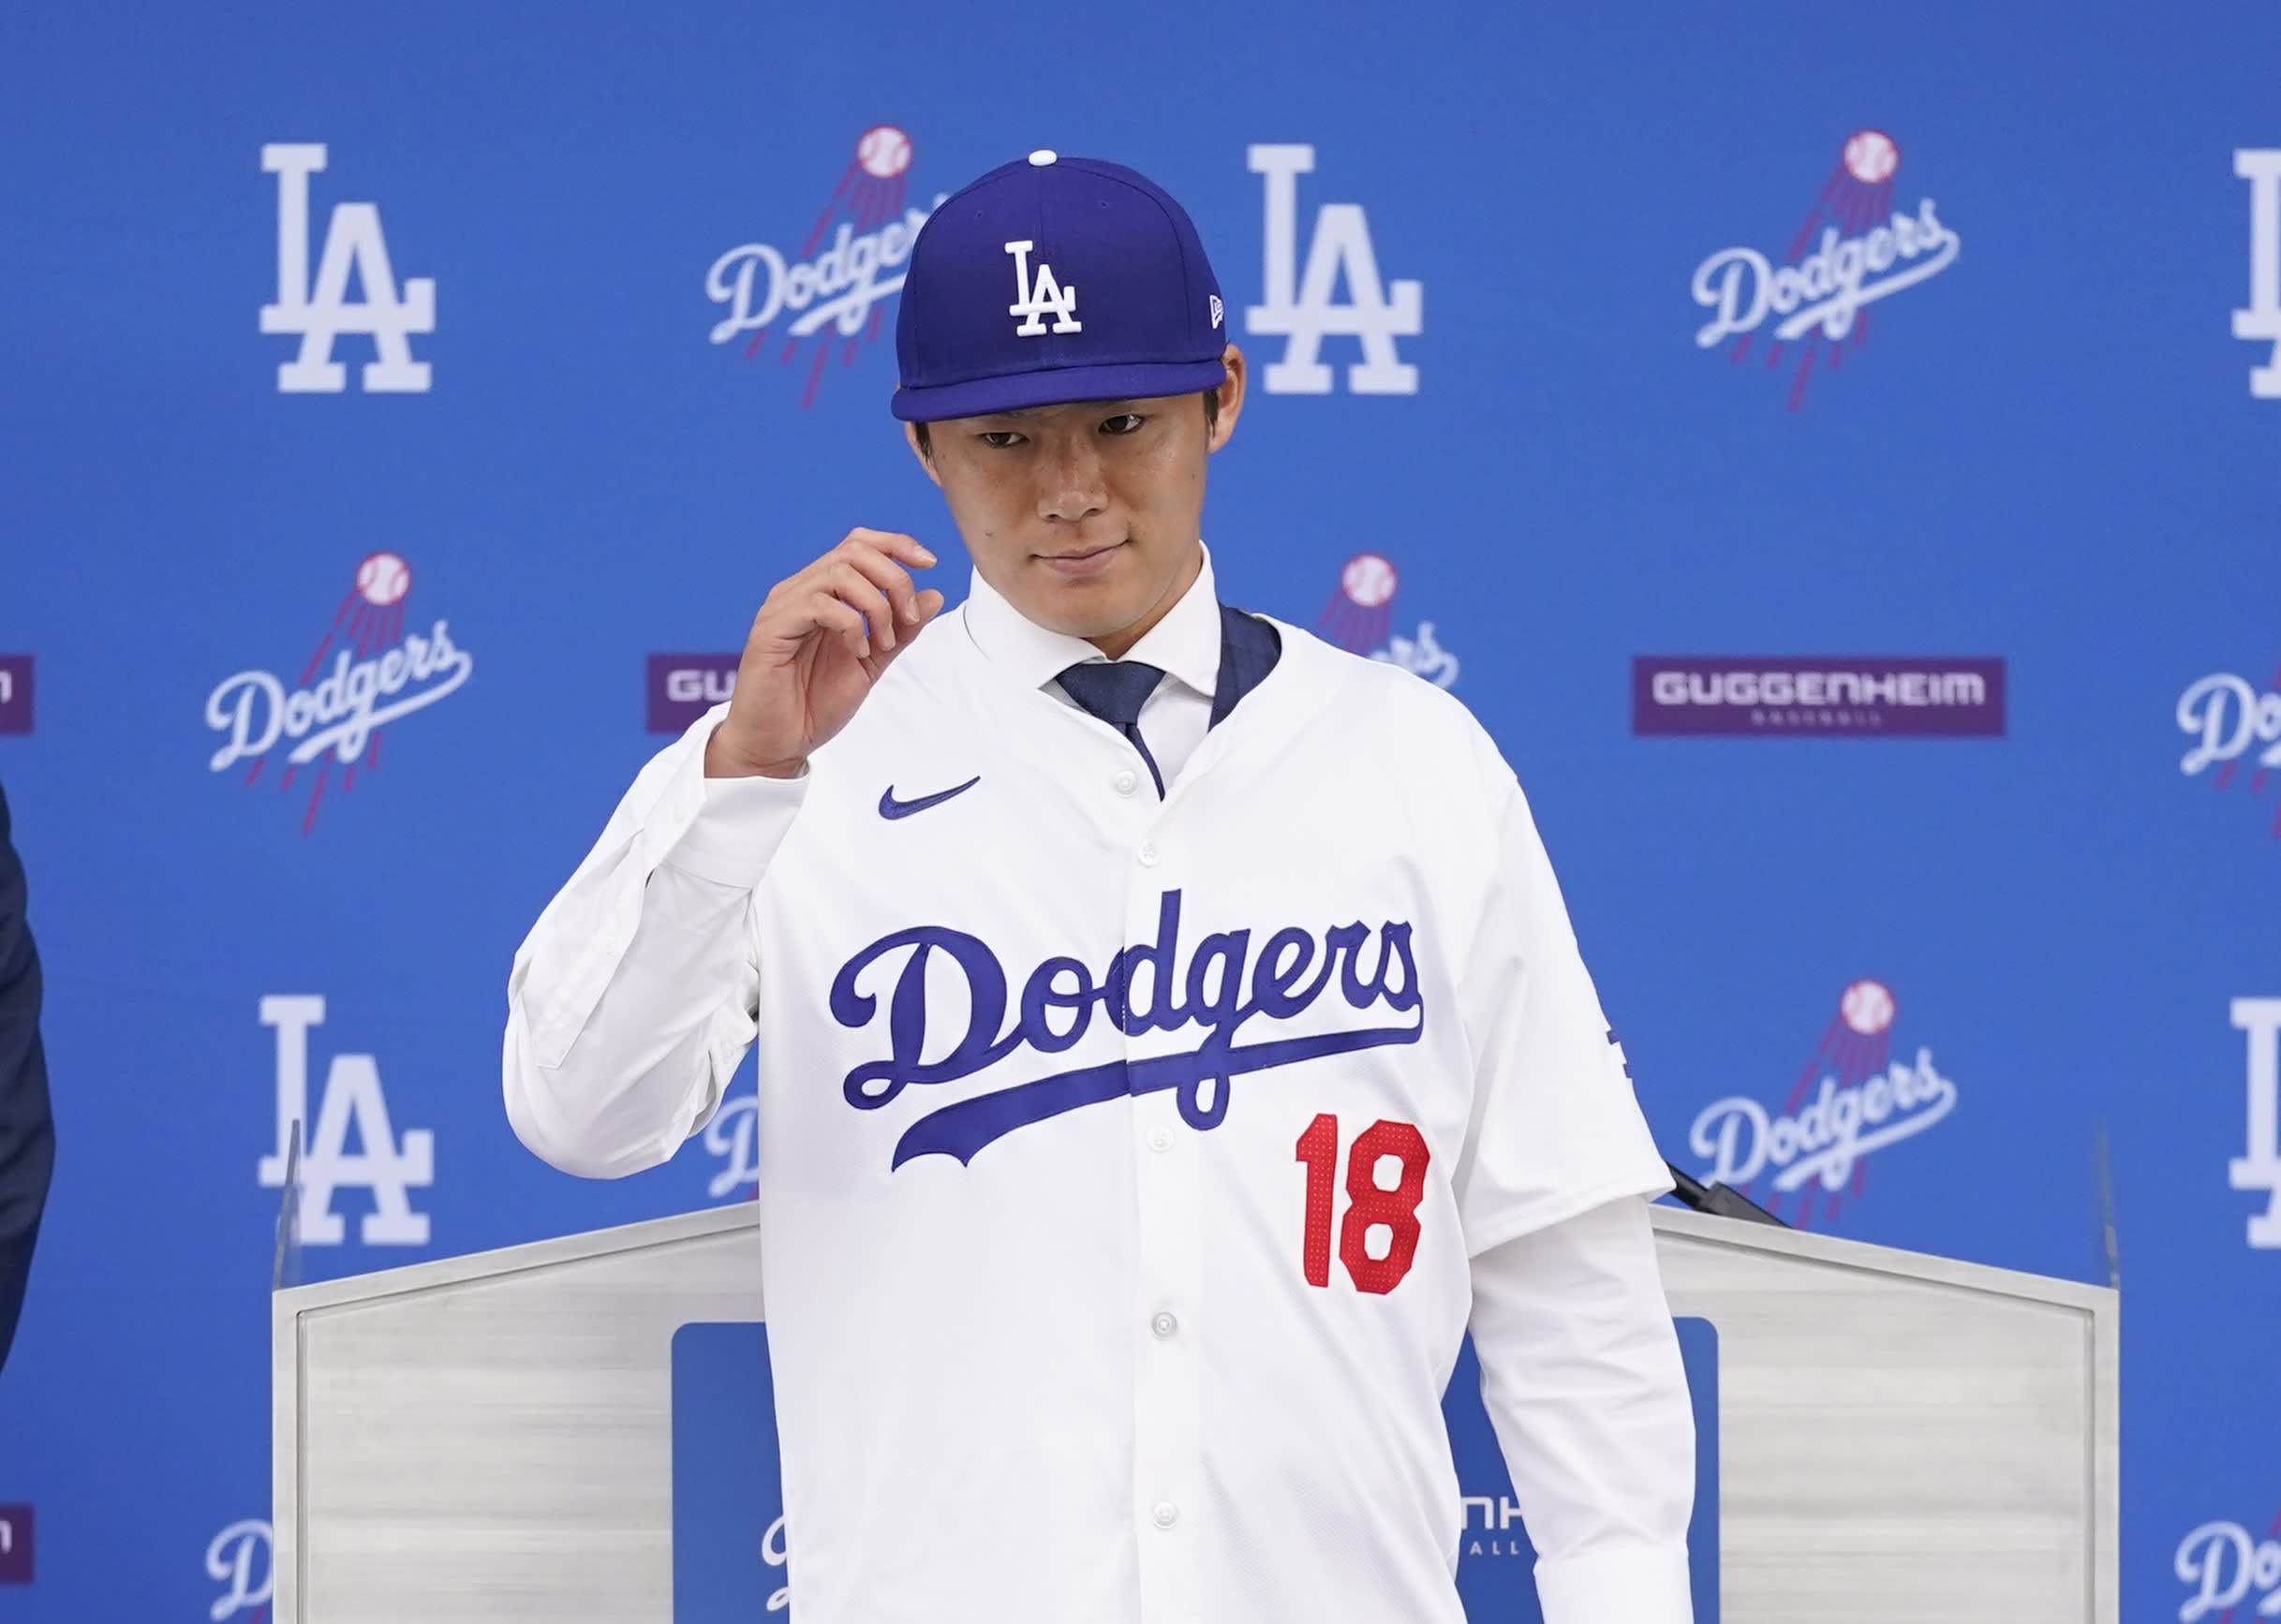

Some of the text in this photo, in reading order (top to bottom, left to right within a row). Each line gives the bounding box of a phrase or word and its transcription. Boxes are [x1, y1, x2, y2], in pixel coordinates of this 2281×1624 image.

[259, 143, 436, 392] LA
[1004, 240, 1082, 337] LA
[1247, 144, 1423, 394] LA
[1691, 198, 1960, 347] Dodgers
[205, 619, 473, 773] Dodgers
[1652, 672, 1986, 705] GUGGENHEIM
[829, 888, 1425, 1173] Dodgers
[259, 995, 435, 1245] LA
[1689, 1045, 1958, 1192] Dodgers
[1296, 1113, 1431, 1295] 18
